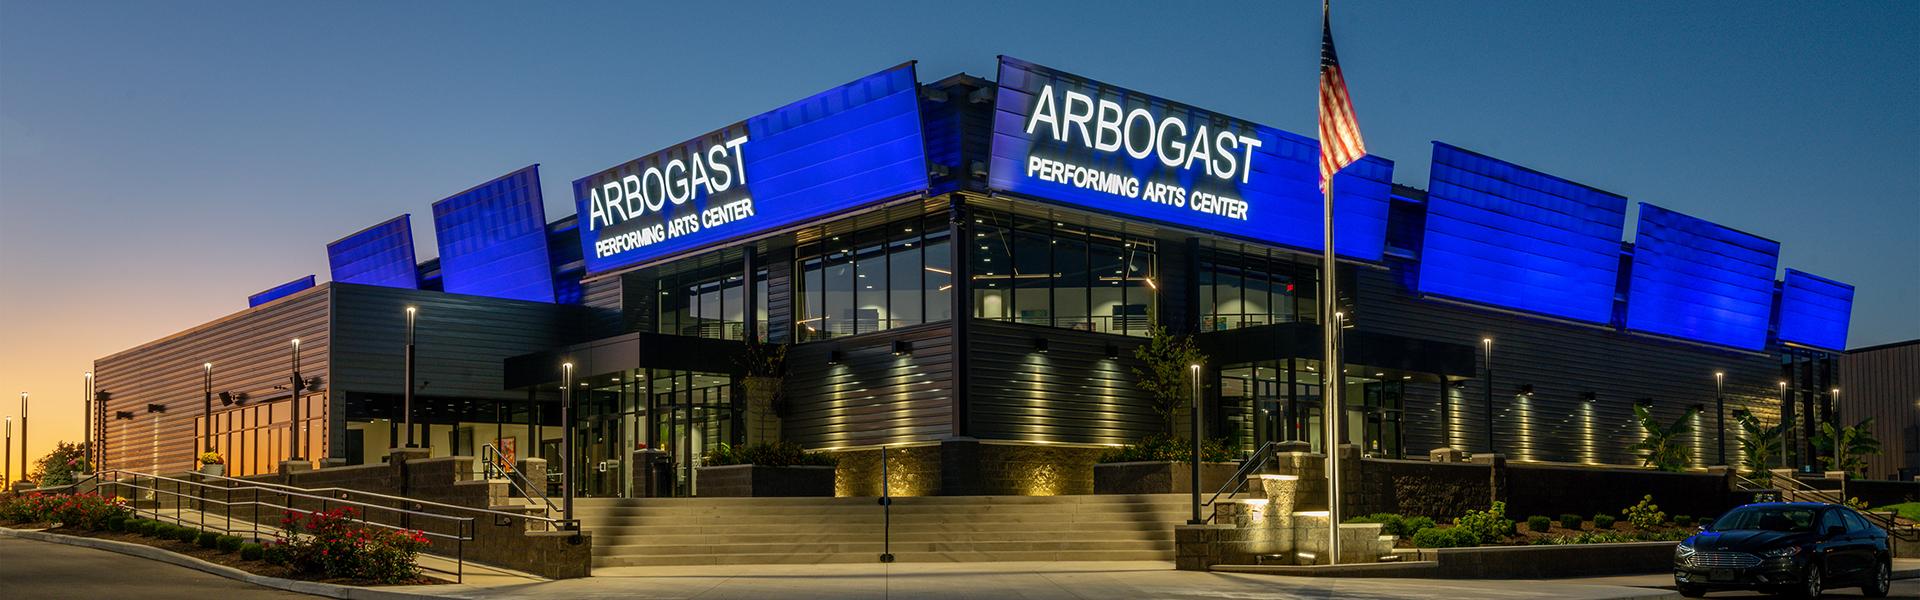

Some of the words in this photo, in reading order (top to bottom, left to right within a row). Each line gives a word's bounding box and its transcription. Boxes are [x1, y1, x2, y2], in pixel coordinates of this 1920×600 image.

[1027, 84, 1262, 184] ARBOGAST
[590, 136, 748, 231] ARBOGAST
[1028, 156, 1139, 198] PERFORMING
[1142, 182, 1186, 207] ARTS
[1190, 192, 1249, 220] CENTER
[595, 223, 665, 258] PERFORMING
[668, 214, 699, 239] ARTS
[702, 199, 754, 228] CENTER
